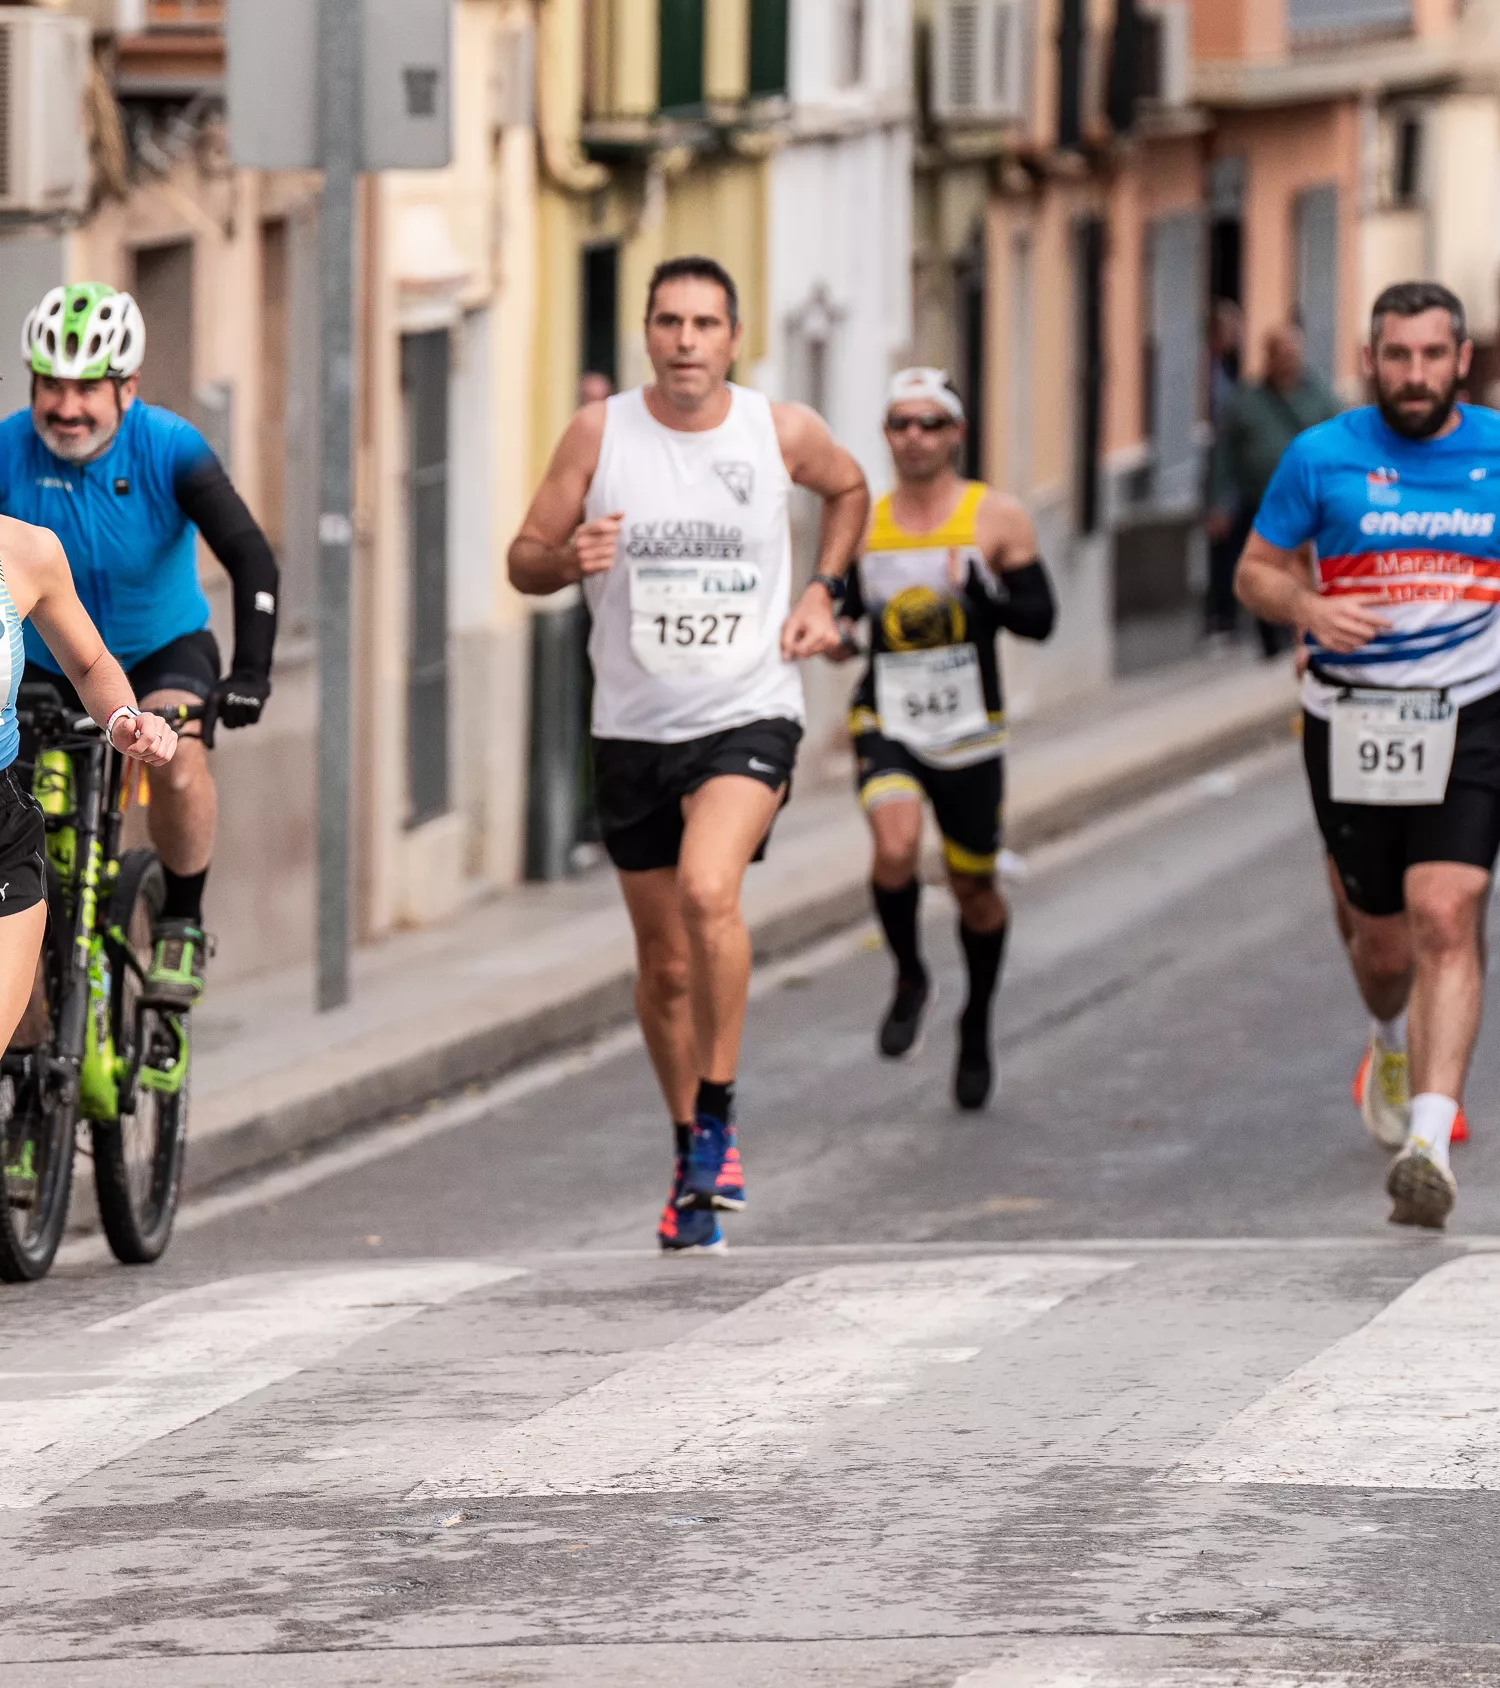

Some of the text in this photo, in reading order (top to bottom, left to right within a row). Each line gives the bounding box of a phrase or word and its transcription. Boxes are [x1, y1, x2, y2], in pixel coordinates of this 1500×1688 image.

[661, 519, 743, 541] CASTILLO
[1360, 508, 1496, 540] enerplus
[653, 613, 743, 647] 1527
[1359, 740, 1426, 773] 951
